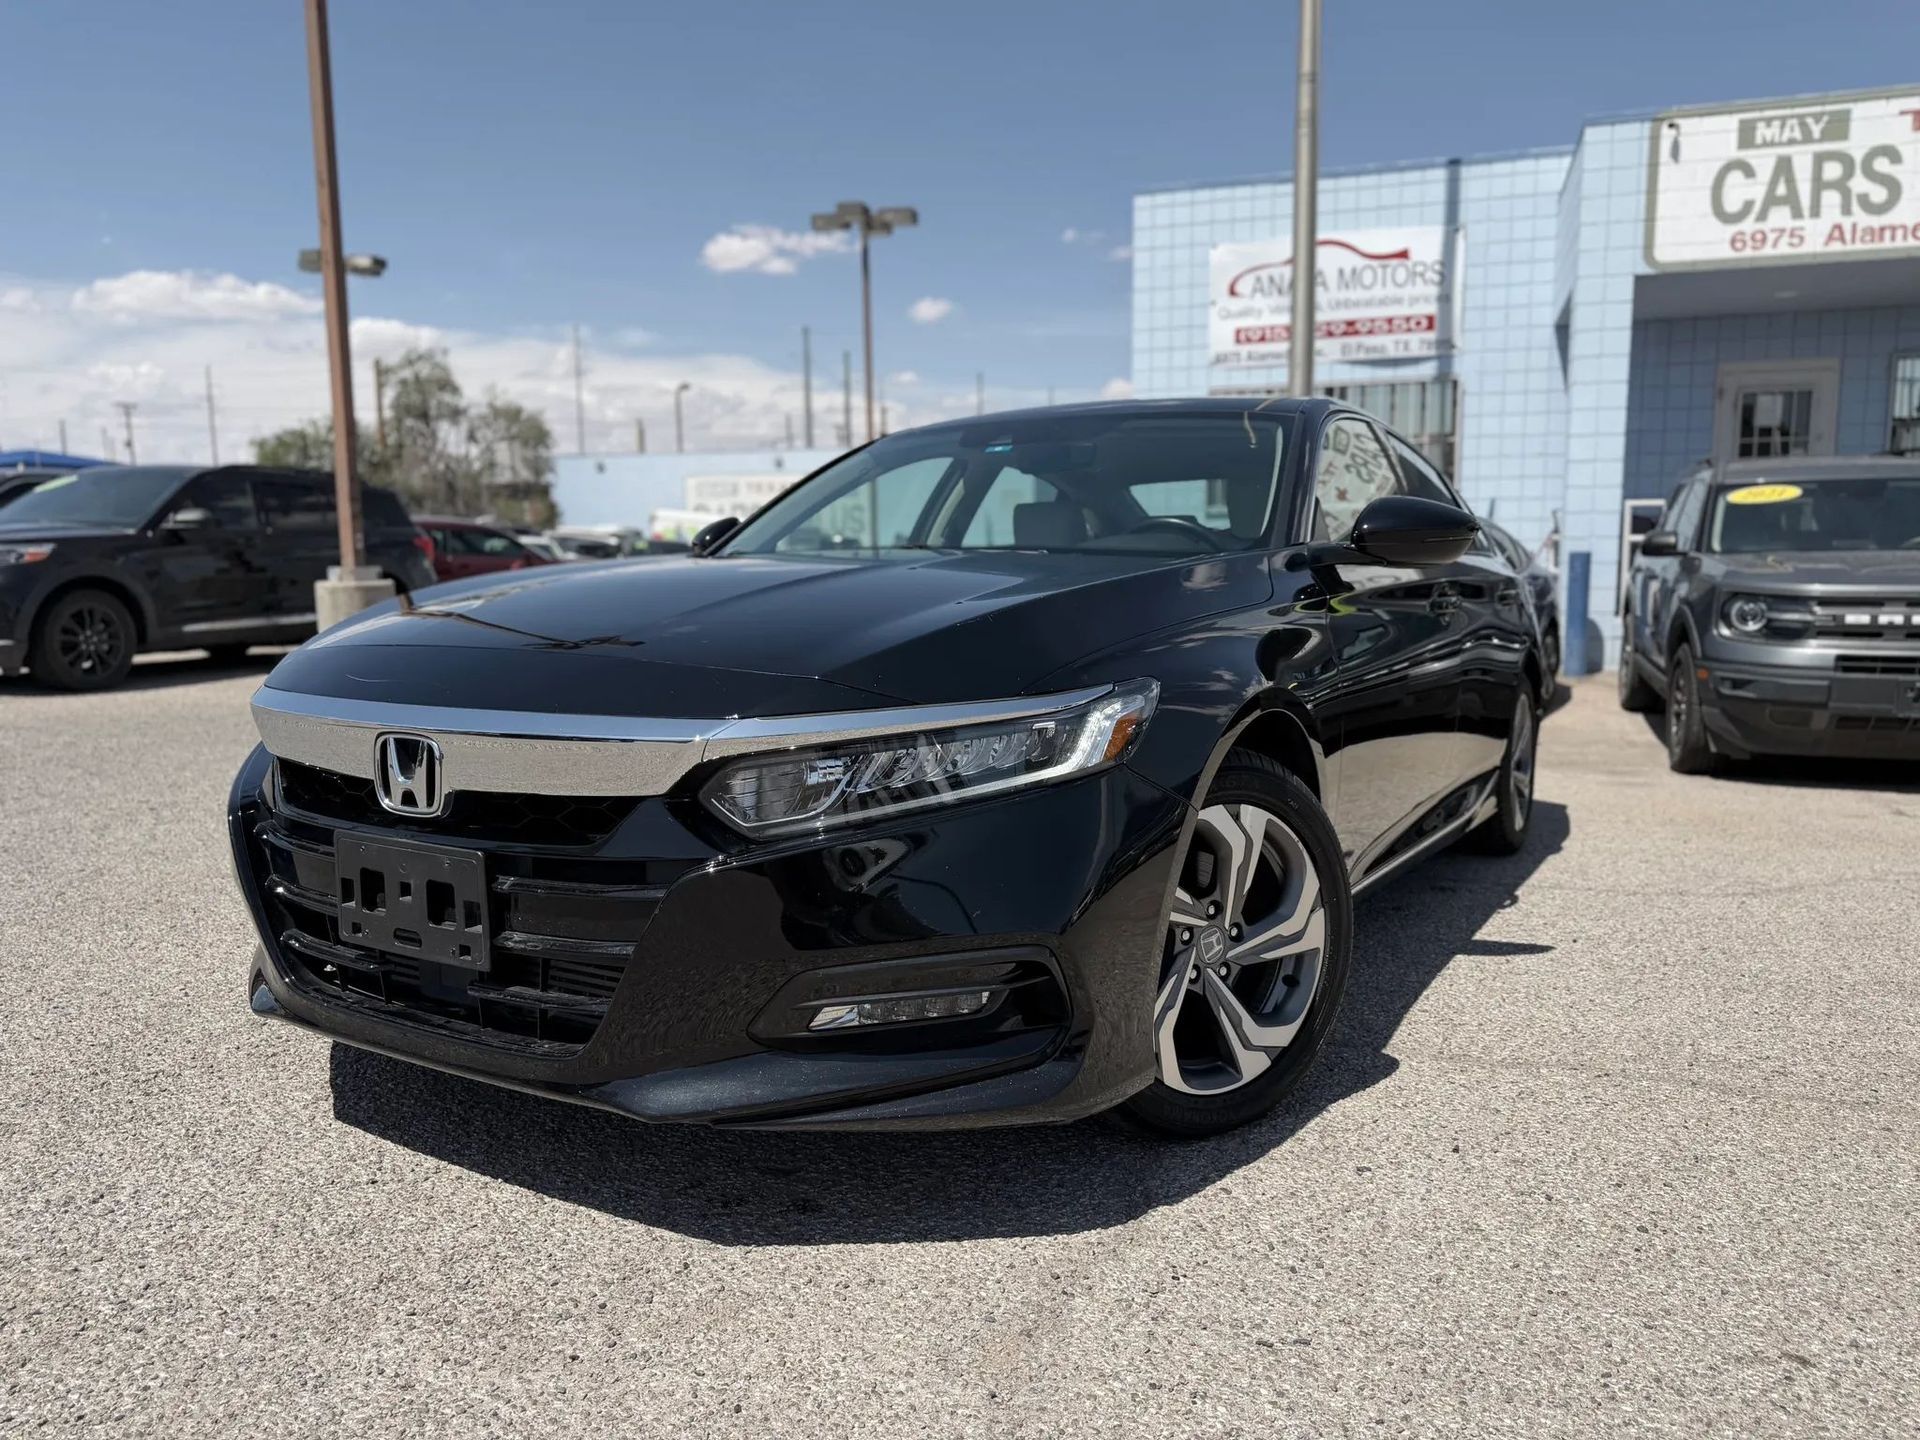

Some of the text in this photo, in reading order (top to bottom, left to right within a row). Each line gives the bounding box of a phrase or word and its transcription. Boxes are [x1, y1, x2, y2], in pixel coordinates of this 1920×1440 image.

[1754, 115, 1830, 145] MAY
[1710, 144, 1904, 225] CARS
[1730, 226, 1806, 253] 6975
[1337, 260, 1446, 293] MOTORS
